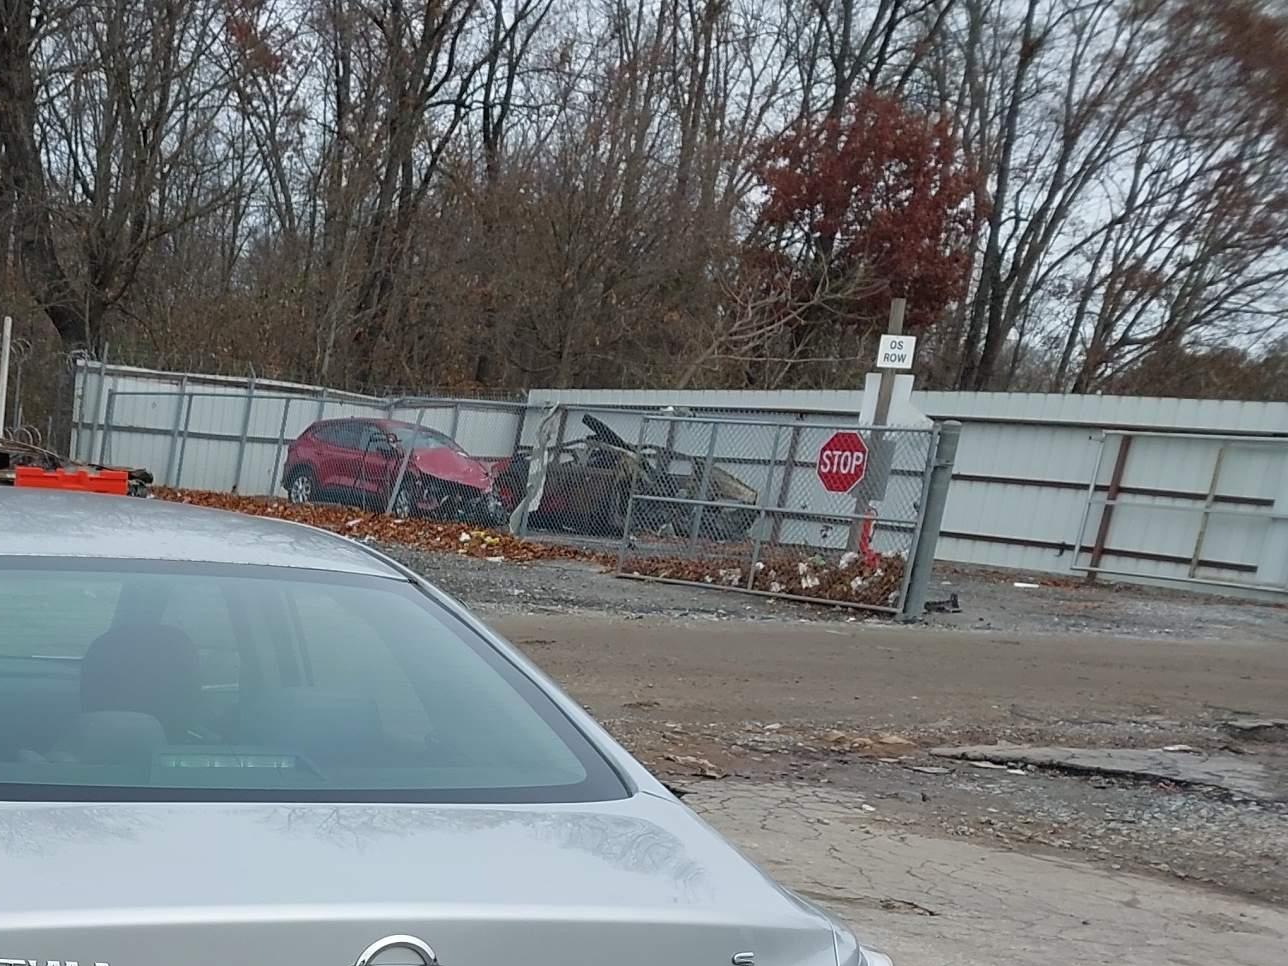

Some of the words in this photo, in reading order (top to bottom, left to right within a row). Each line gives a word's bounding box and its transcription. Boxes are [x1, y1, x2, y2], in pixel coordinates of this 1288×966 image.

[890, 340, 904, 350] OS
[883, 353, 907, 363] ROW
[820, 450, 863, 474] STOP
